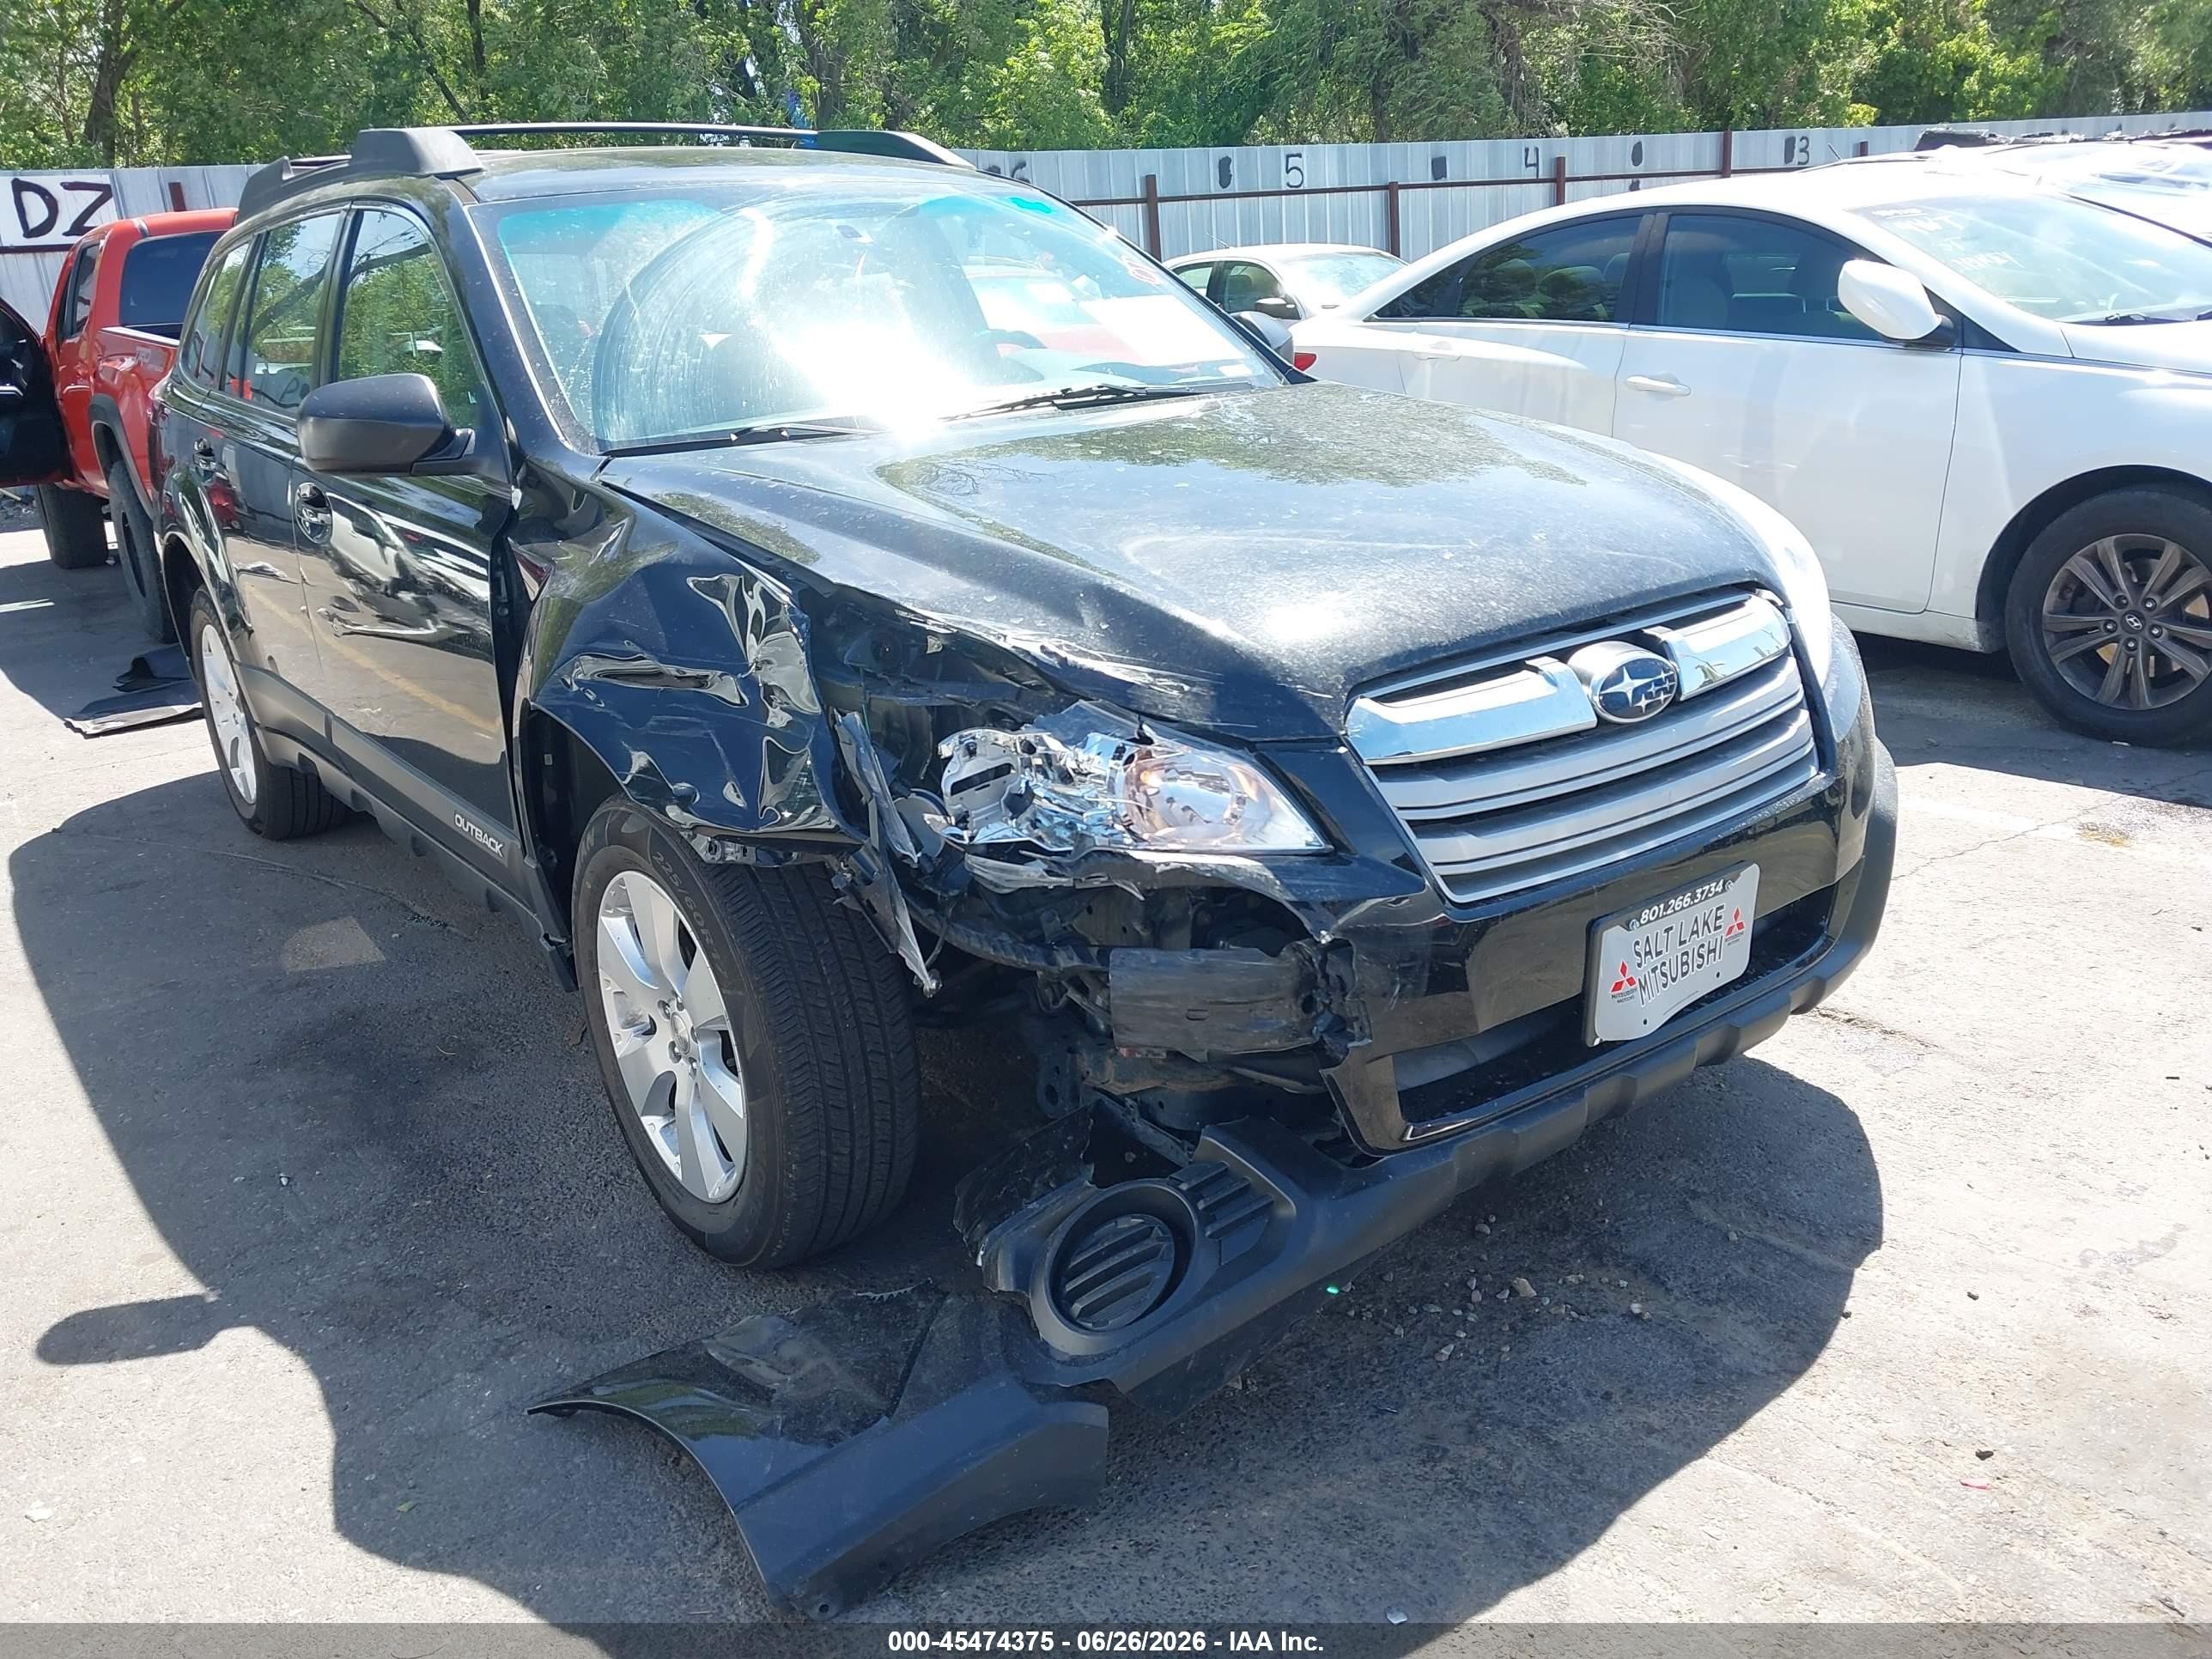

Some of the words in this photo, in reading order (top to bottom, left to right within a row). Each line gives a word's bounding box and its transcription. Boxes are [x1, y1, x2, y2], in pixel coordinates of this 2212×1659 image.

[1285, 153, 1304, 188] 5
[1524, 146, 1539, 179] 4
[1797, 136, 1810, 166] 3
[454, 813, 504, 859] OUTBACK
[1639, 879, 1724, 925] 801.266.3734
[1633, 926, 1674, 969] SALT
[1678, 904, 1726, 946] LAKE
[1638, 935, 1724, 1006] MITSUBISHI
